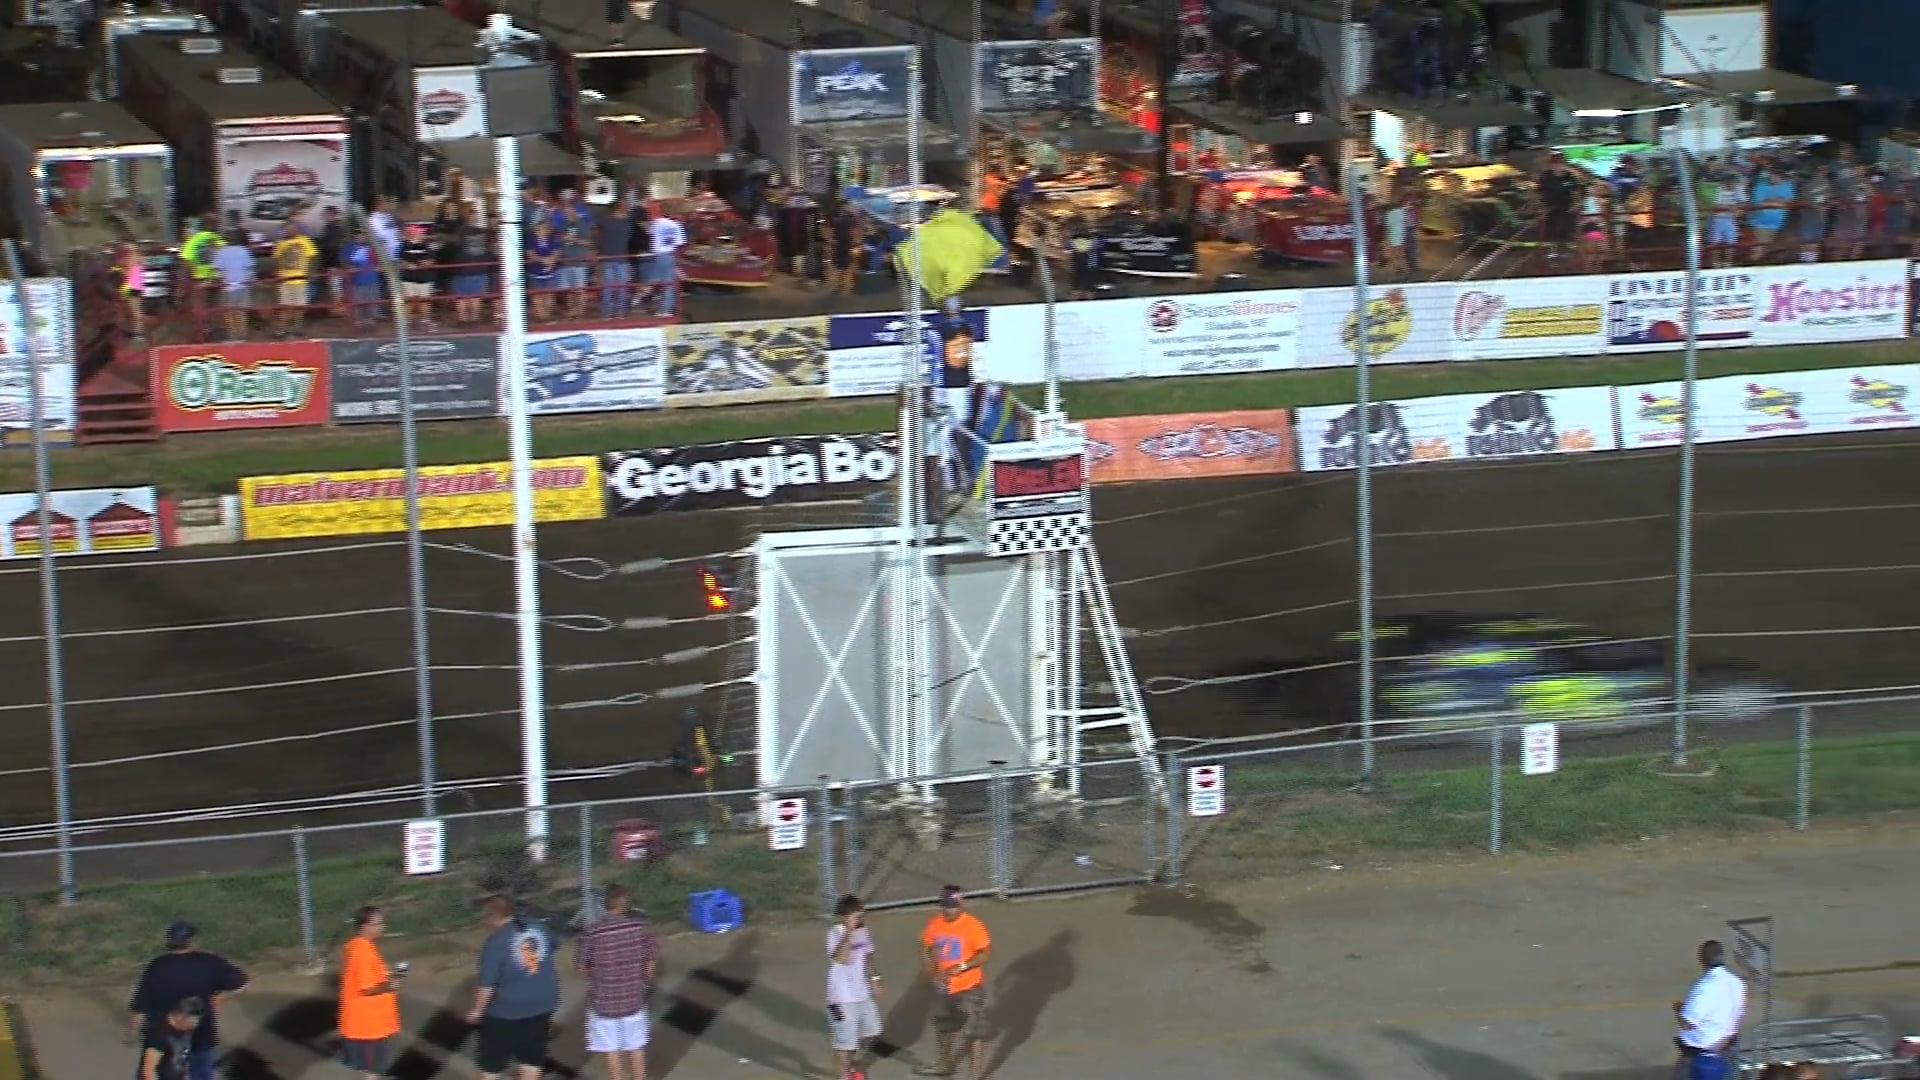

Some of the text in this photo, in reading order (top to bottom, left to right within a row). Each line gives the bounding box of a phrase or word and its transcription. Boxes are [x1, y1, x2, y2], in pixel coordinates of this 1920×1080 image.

[815, 72, 888, 94] PEAK
[1292, 224, 1356, 241] LUCAS
[1698, 274, 1751, 291] CITY
[1760, 275, 1904, 322] Hoosier
[760, 347, 808, 361] NTC
[334, 358, 493, 377] TRUC CENTER
[173, 360, 309, 405] O'Reilly
[615, 442, 898, 499] Georgia Bo
